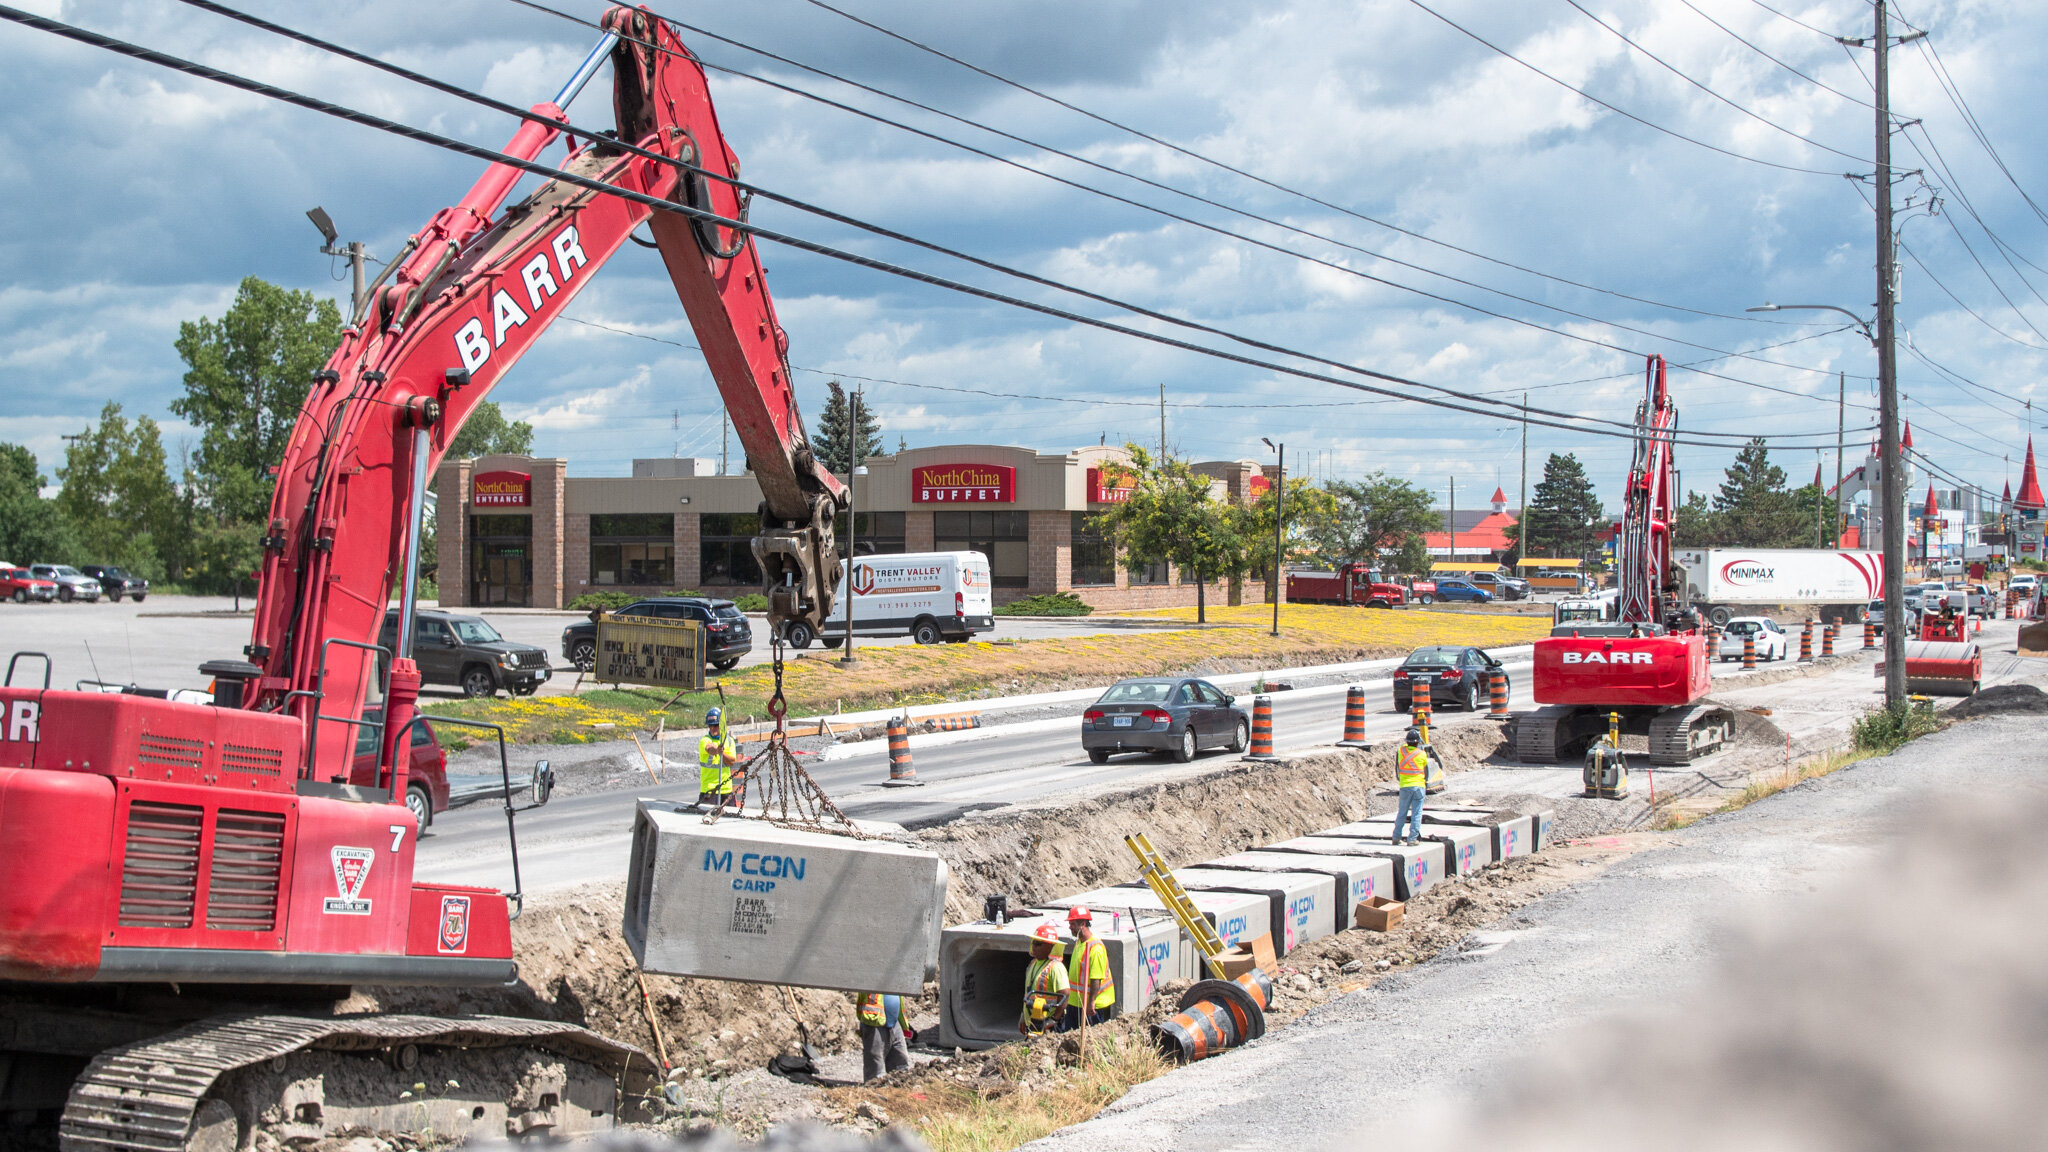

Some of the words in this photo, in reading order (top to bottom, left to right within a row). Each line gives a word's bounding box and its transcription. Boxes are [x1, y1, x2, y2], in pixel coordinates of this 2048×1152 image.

[453, 224, 590, 377] BARR
[922, 469, 1000, 486] NorthChina
[476, 481, 523, 493] NorthChina
[922, 489, 1000, 500] BUFFET
[876, 568, 904, 577] TRENT
[907, 567, 941, 576] VALLEY
[878, 575, 939, 583] DISTRIBUTORS
[1730, 567, 1774, 578] MINIMAX
[627, 616, 647, 624] VALLEY
[1562, 651, 1653, 665] BARR
[389, 824, 407, 853] 7
[336, 850, 370, 858] EXCAVATING
[703, 849, 733, 873] M
[741, 853, 806, 881] CON
[336, 864, 347, 894] WATER
[731, 878, 776, 893] CARP
[1352, 881, 1360, 896] M
[1290, 899, 1298, 918] M
[1299, 894, 1315, 915] CON
[1219, 920, 1228, 939] M
[1229, 915, 1247, 936] CON
[1150, 940, 1170, 961] CON
